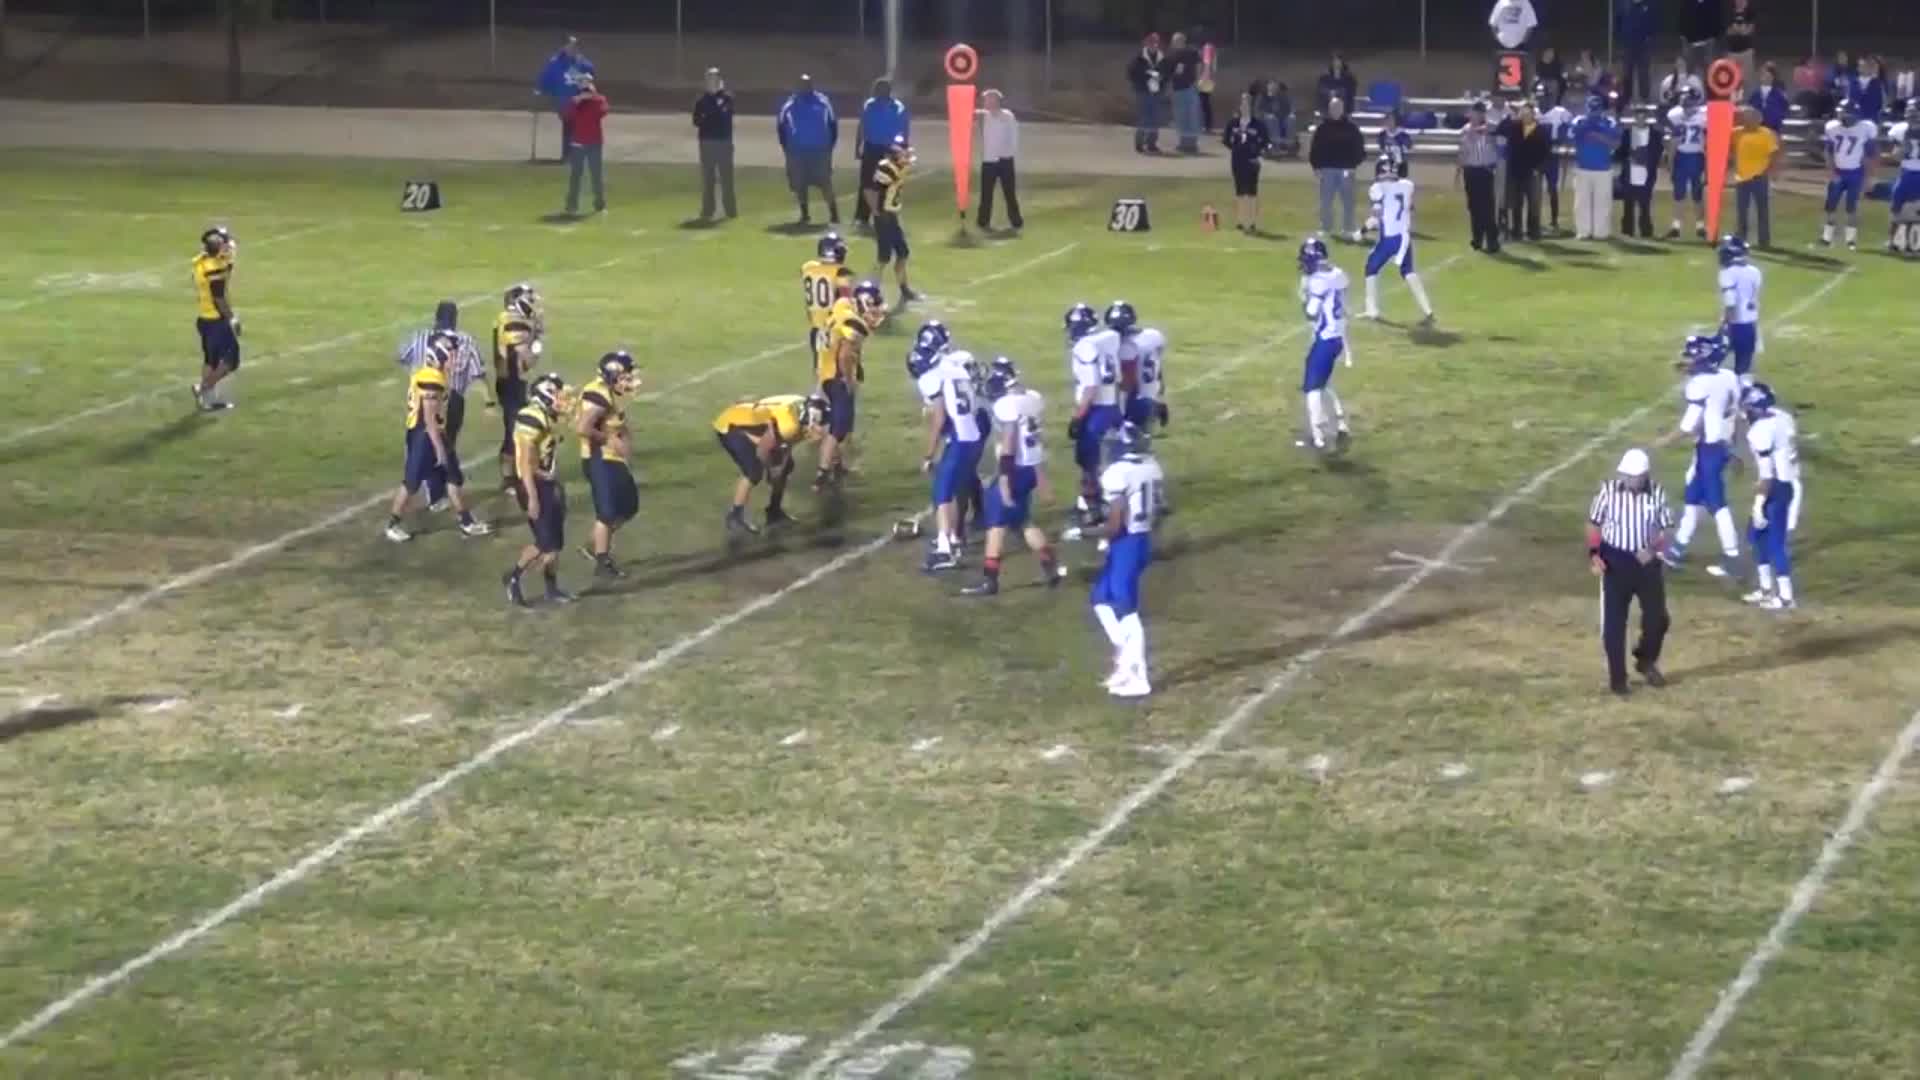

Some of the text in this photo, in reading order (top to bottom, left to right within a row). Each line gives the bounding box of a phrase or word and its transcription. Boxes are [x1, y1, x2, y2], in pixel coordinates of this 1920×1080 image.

[1499, 56, 1521, 86] 3
[1834, 136, 1863, 155] 77
[403, 184, 429, 207] 20
[1112, 204, 1139, 230] 30
